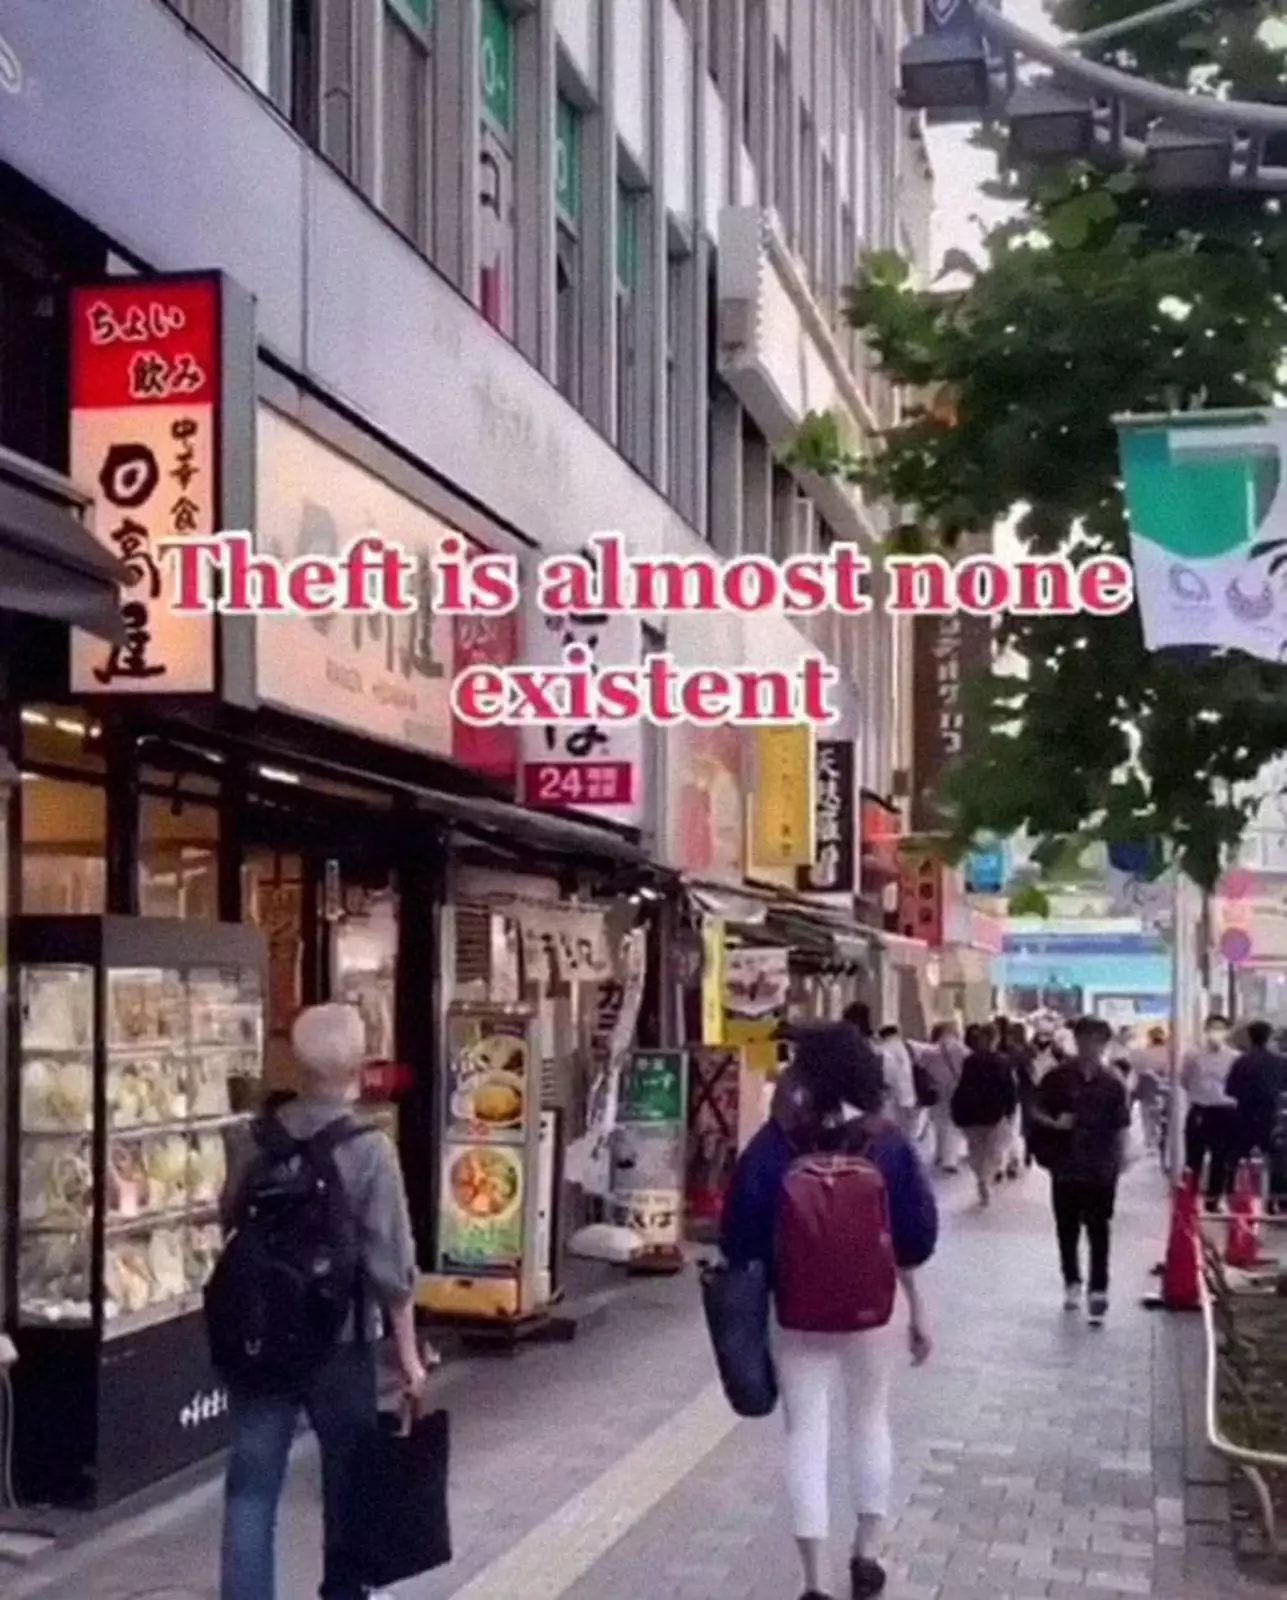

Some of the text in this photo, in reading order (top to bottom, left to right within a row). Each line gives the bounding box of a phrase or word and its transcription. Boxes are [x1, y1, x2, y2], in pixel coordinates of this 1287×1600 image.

[88, 302, 186, 345] ちょい
[128, 353, 206, 400] 飲み
